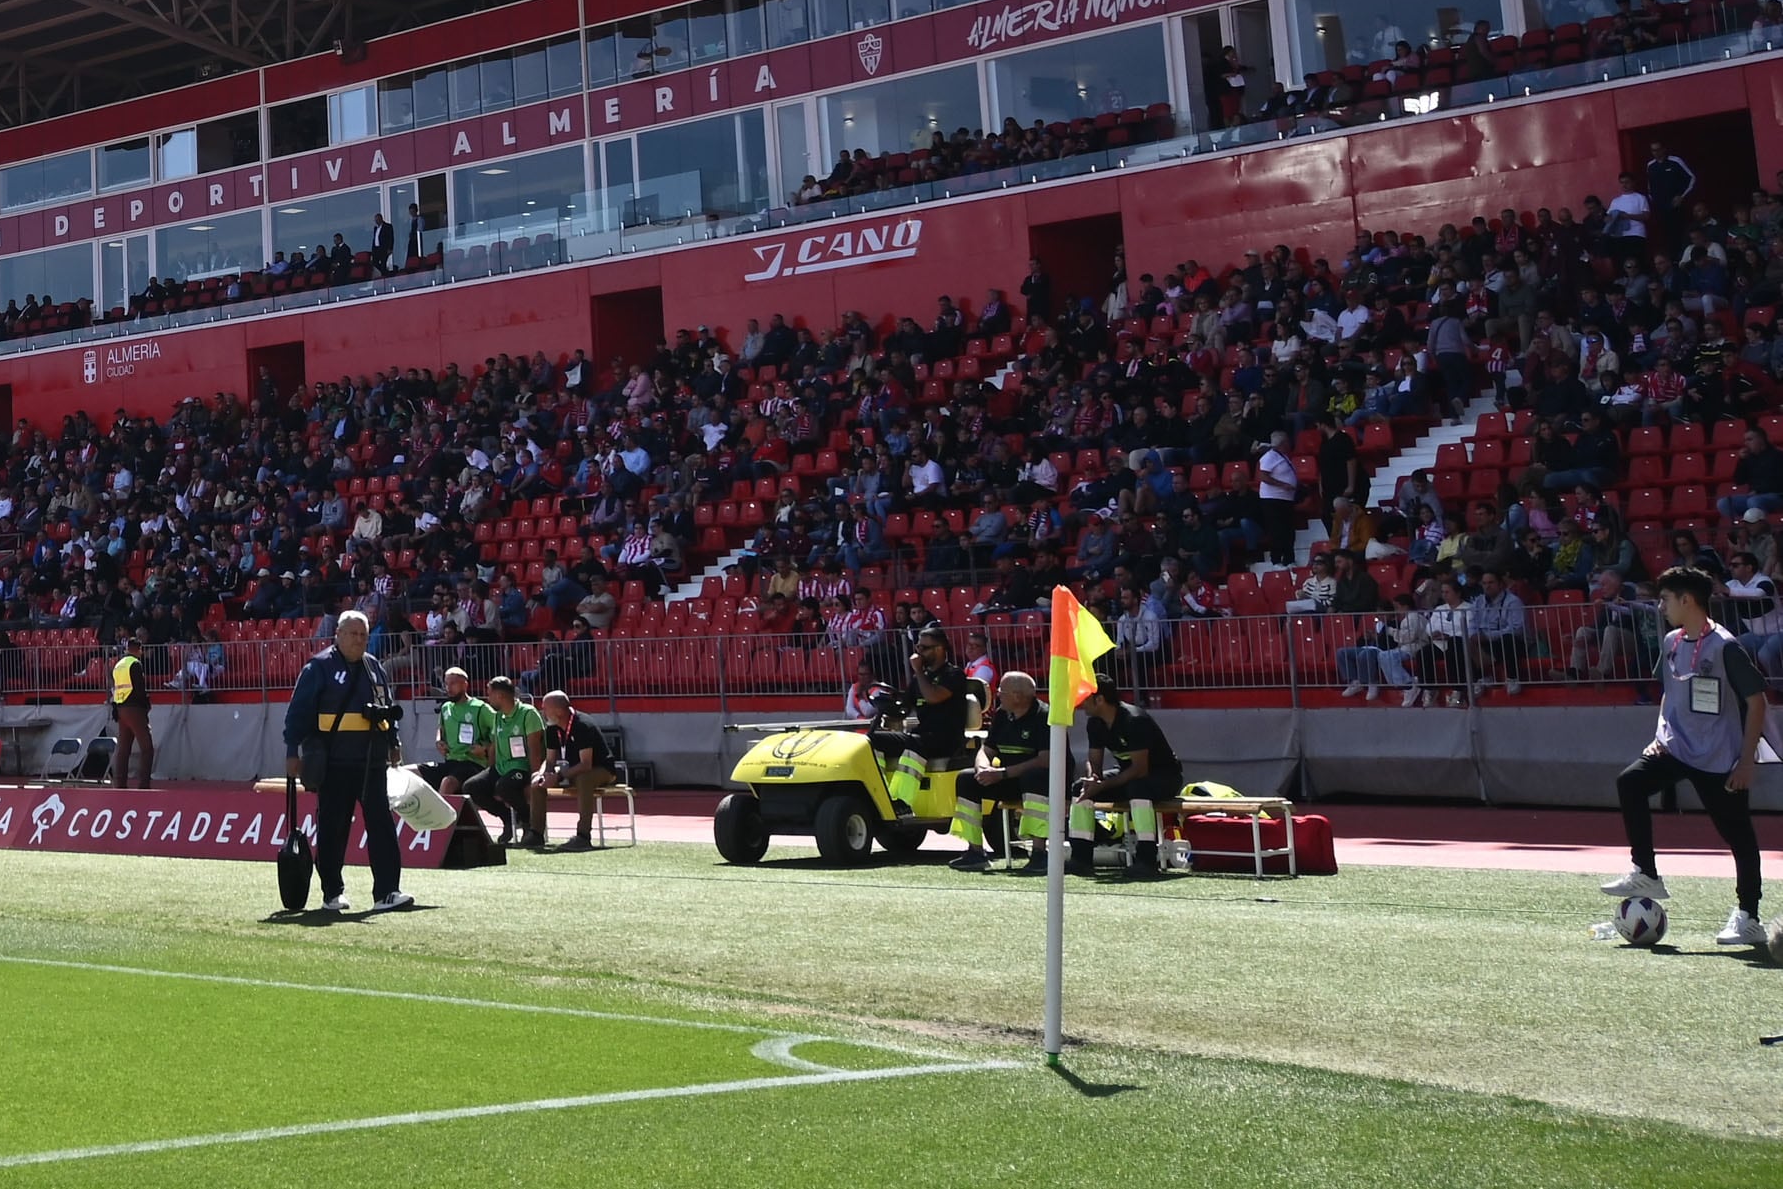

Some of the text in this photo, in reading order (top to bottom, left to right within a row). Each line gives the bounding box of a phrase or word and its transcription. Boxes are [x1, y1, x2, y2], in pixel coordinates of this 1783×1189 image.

[55, 149, 388, 237] DEPORTIVA
[453, 64, 777, 157] ALMERÍA
[106, 339, 161, 365] ALMERÍA
[1492, 348, 1503, 361] 4
[106, 364, 135, 378] CIUDAD
